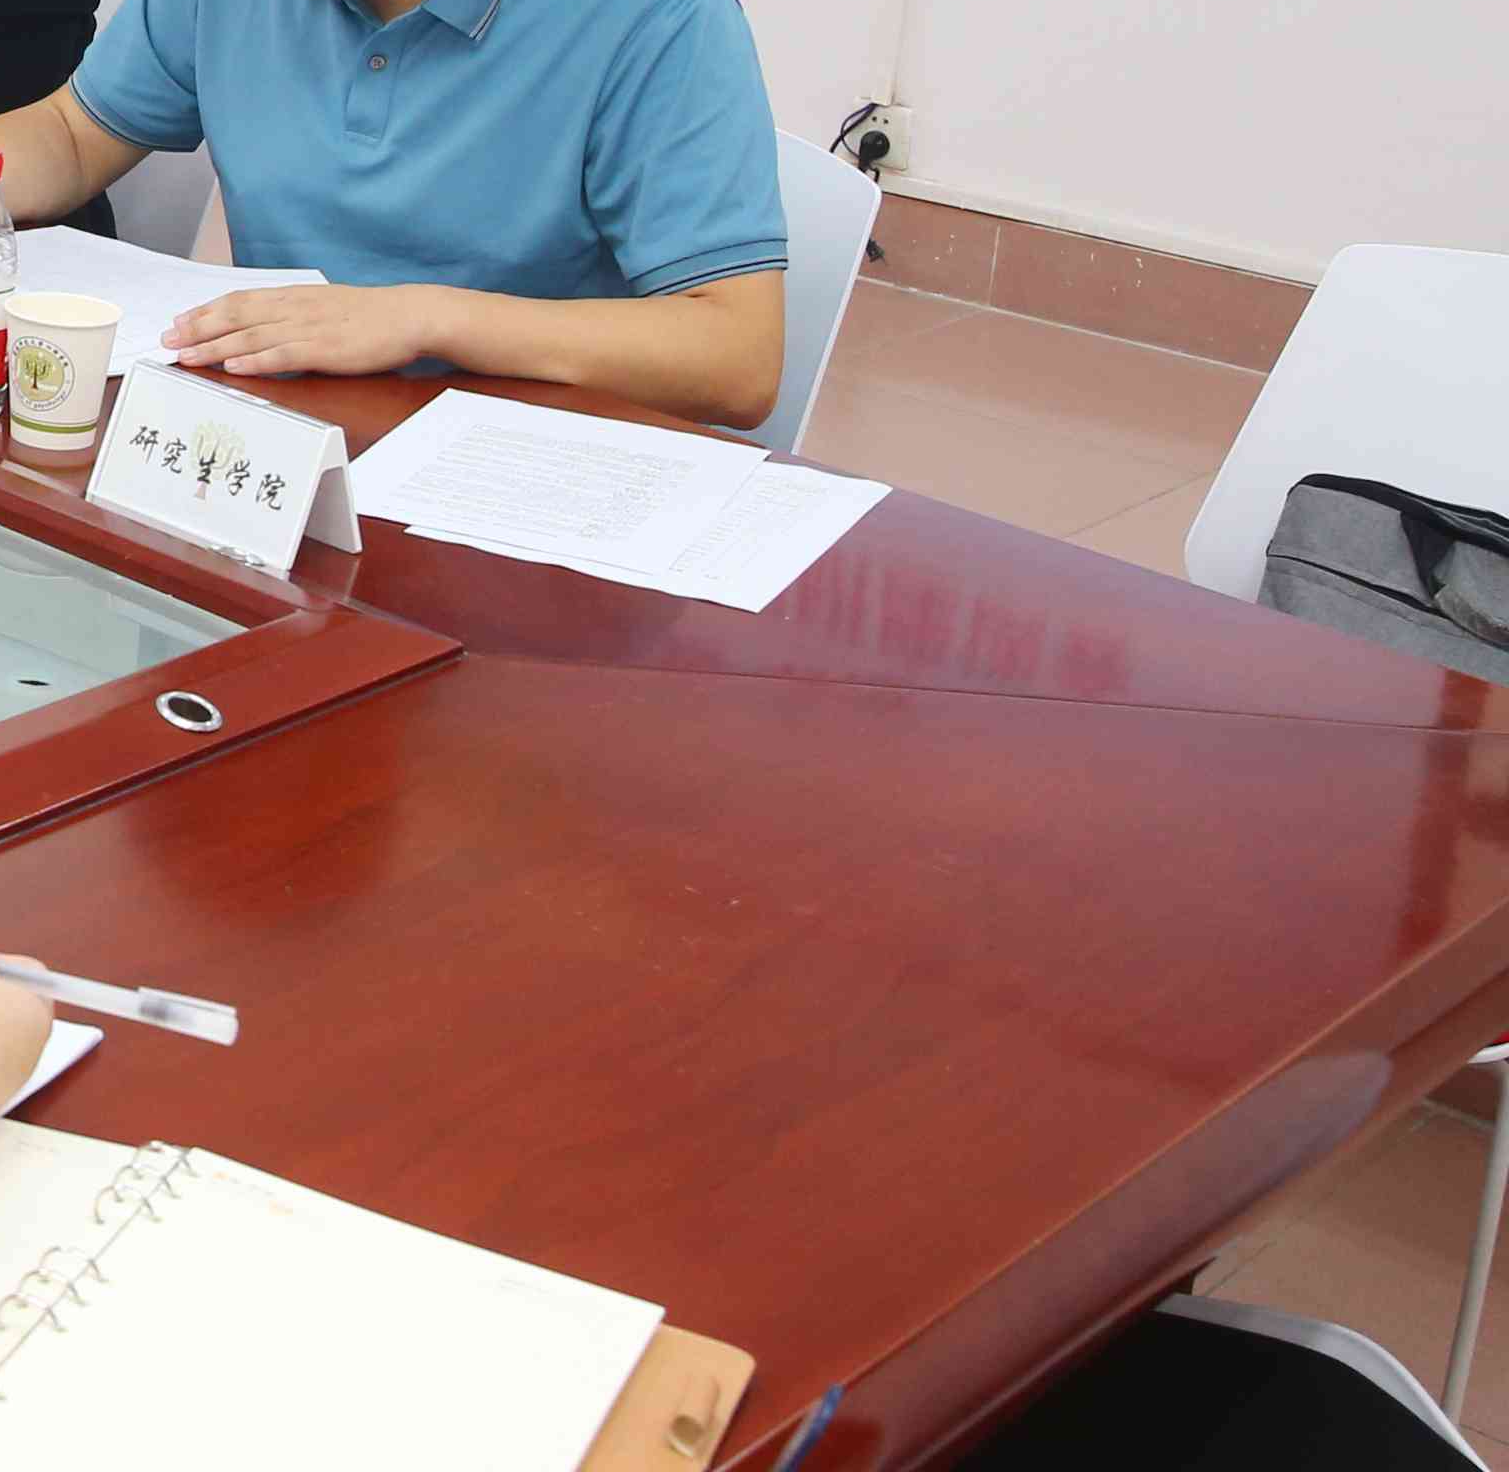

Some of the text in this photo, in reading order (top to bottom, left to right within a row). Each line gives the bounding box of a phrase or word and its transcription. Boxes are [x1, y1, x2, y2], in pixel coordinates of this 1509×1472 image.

[129, 425, 286, 511] 研究生学院
